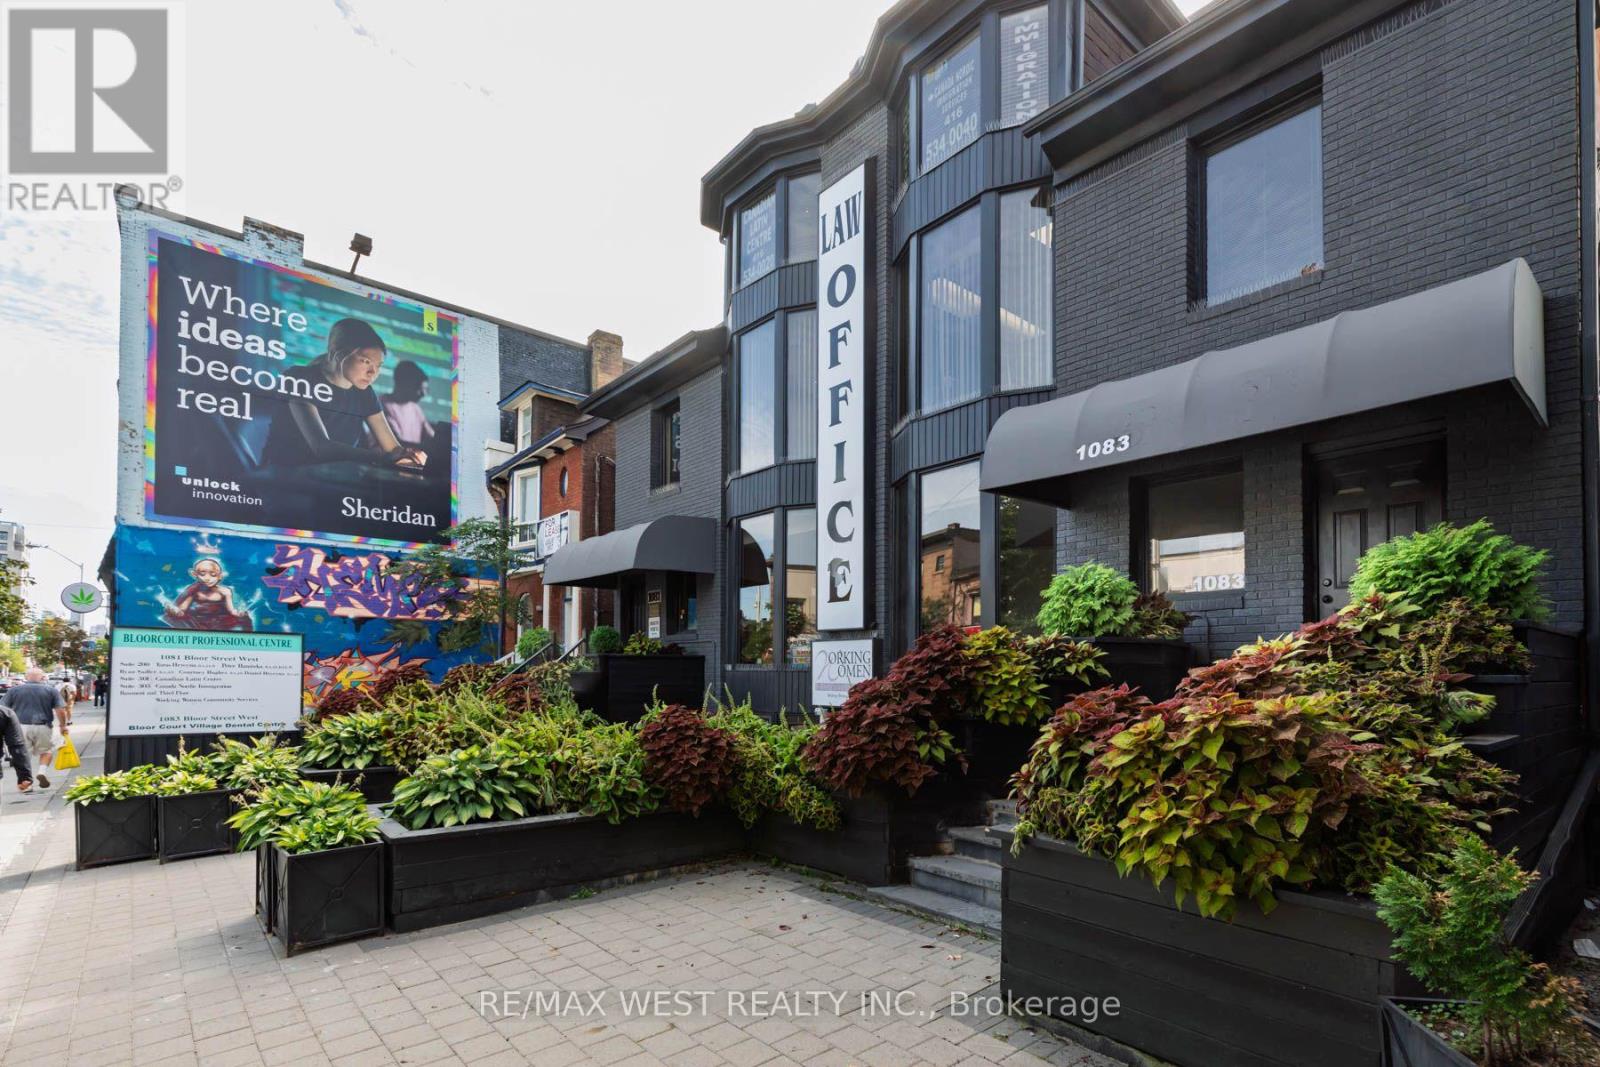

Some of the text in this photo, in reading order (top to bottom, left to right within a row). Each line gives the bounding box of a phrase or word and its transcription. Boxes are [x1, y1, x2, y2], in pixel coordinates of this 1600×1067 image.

[821, 190, 862, 255] LAW
[178, 275, 308, 333] Where
[178, 311, 287, 361] ideas
[177, 345, 334, 403] become
[177, 387, 254, 421] real
[826, 264, 857, 603] OFFICE
[1076, 434, 1130, 461] 1083
[182, 476, 241, 492] unlock
[192, 488, 263, 507] innovation
[341, 496, 437, 528] Sheridan
[1193, 573, 1246, 592] 1083
[123, 633, 293, 648] BLOORCOURT PROFESSIONAL CENTRE
[184, 654, 209, 662] Bloor
[189, 722, 223, 730] Village
